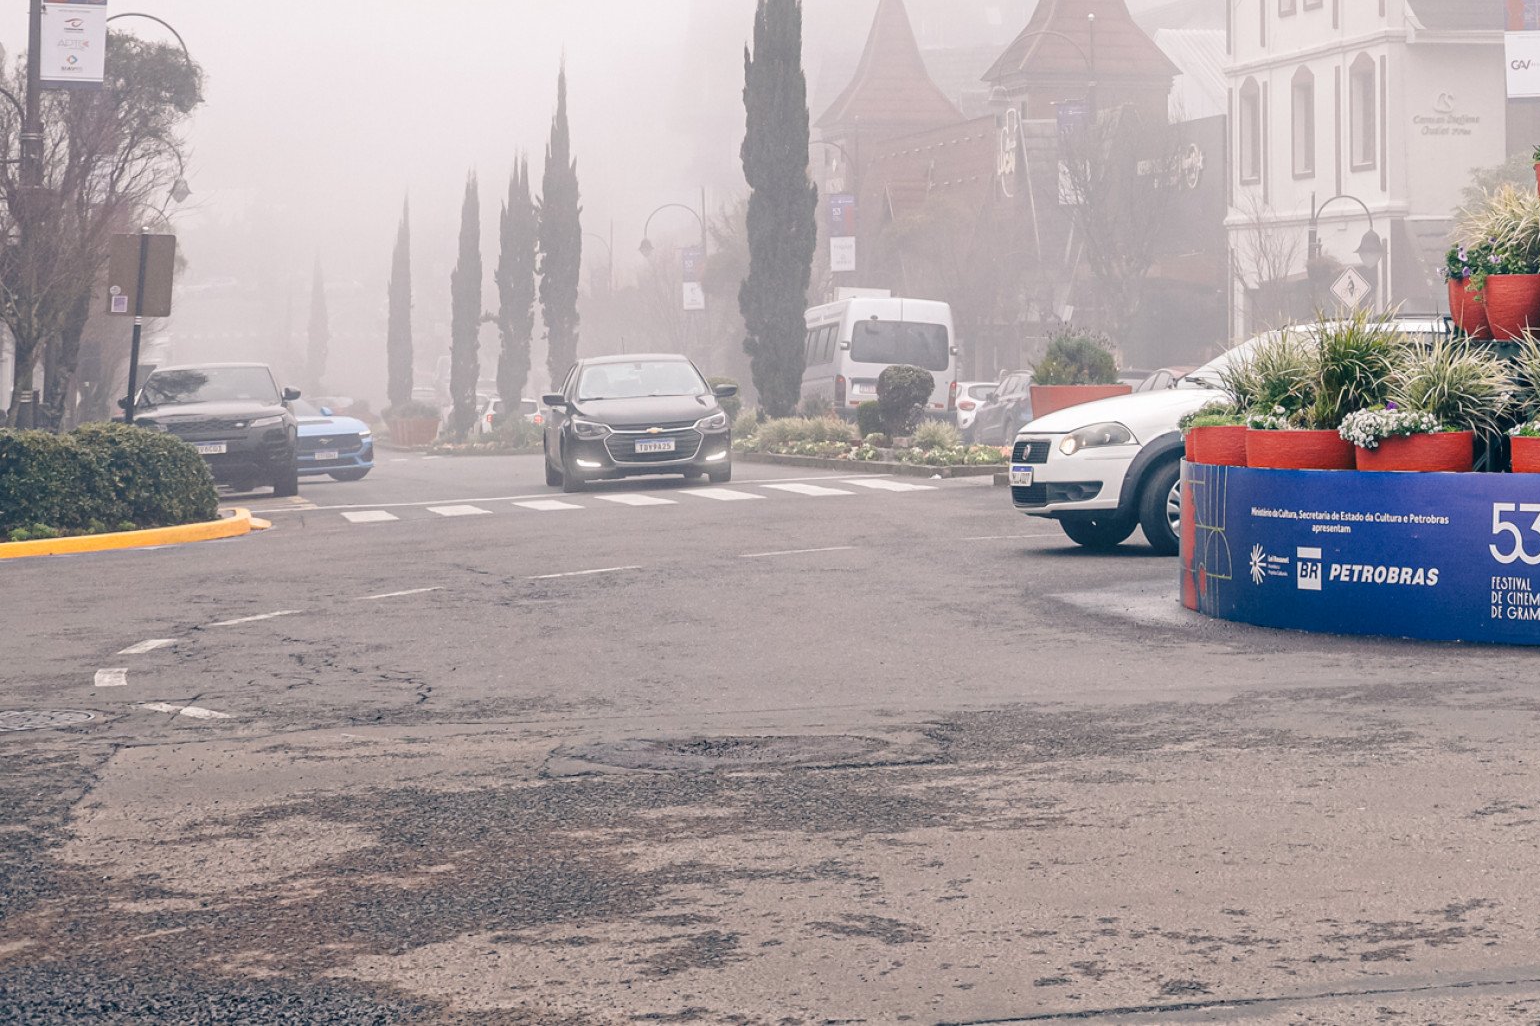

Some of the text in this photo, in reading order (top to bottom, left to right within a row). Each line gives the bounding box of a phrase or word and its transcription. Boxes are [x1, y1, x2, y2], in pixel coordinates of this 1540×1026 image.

[1511, 59, 1531, 70] GAV
[1299, 510, 1330, 520] Secretaria
[1331, 511, 1340, 520] de
[1341, 511, 1364, 521] Estado
[1365, 512, 1374, 522] da
[1374, 512, 1402, 523] Cultura
[1403, 515, 1409, 523] e
[1410, 514, 1449, 524] Petrobras
[1312, 525, 1351, 534] apresentam
[1329, 563, 1440, 586] PETROBRAS
[1491, 577, 1531, 591] FESTIVAL
[1491, 591, 1502, 604] DE
[1491, 606, 1502, 619] DE
